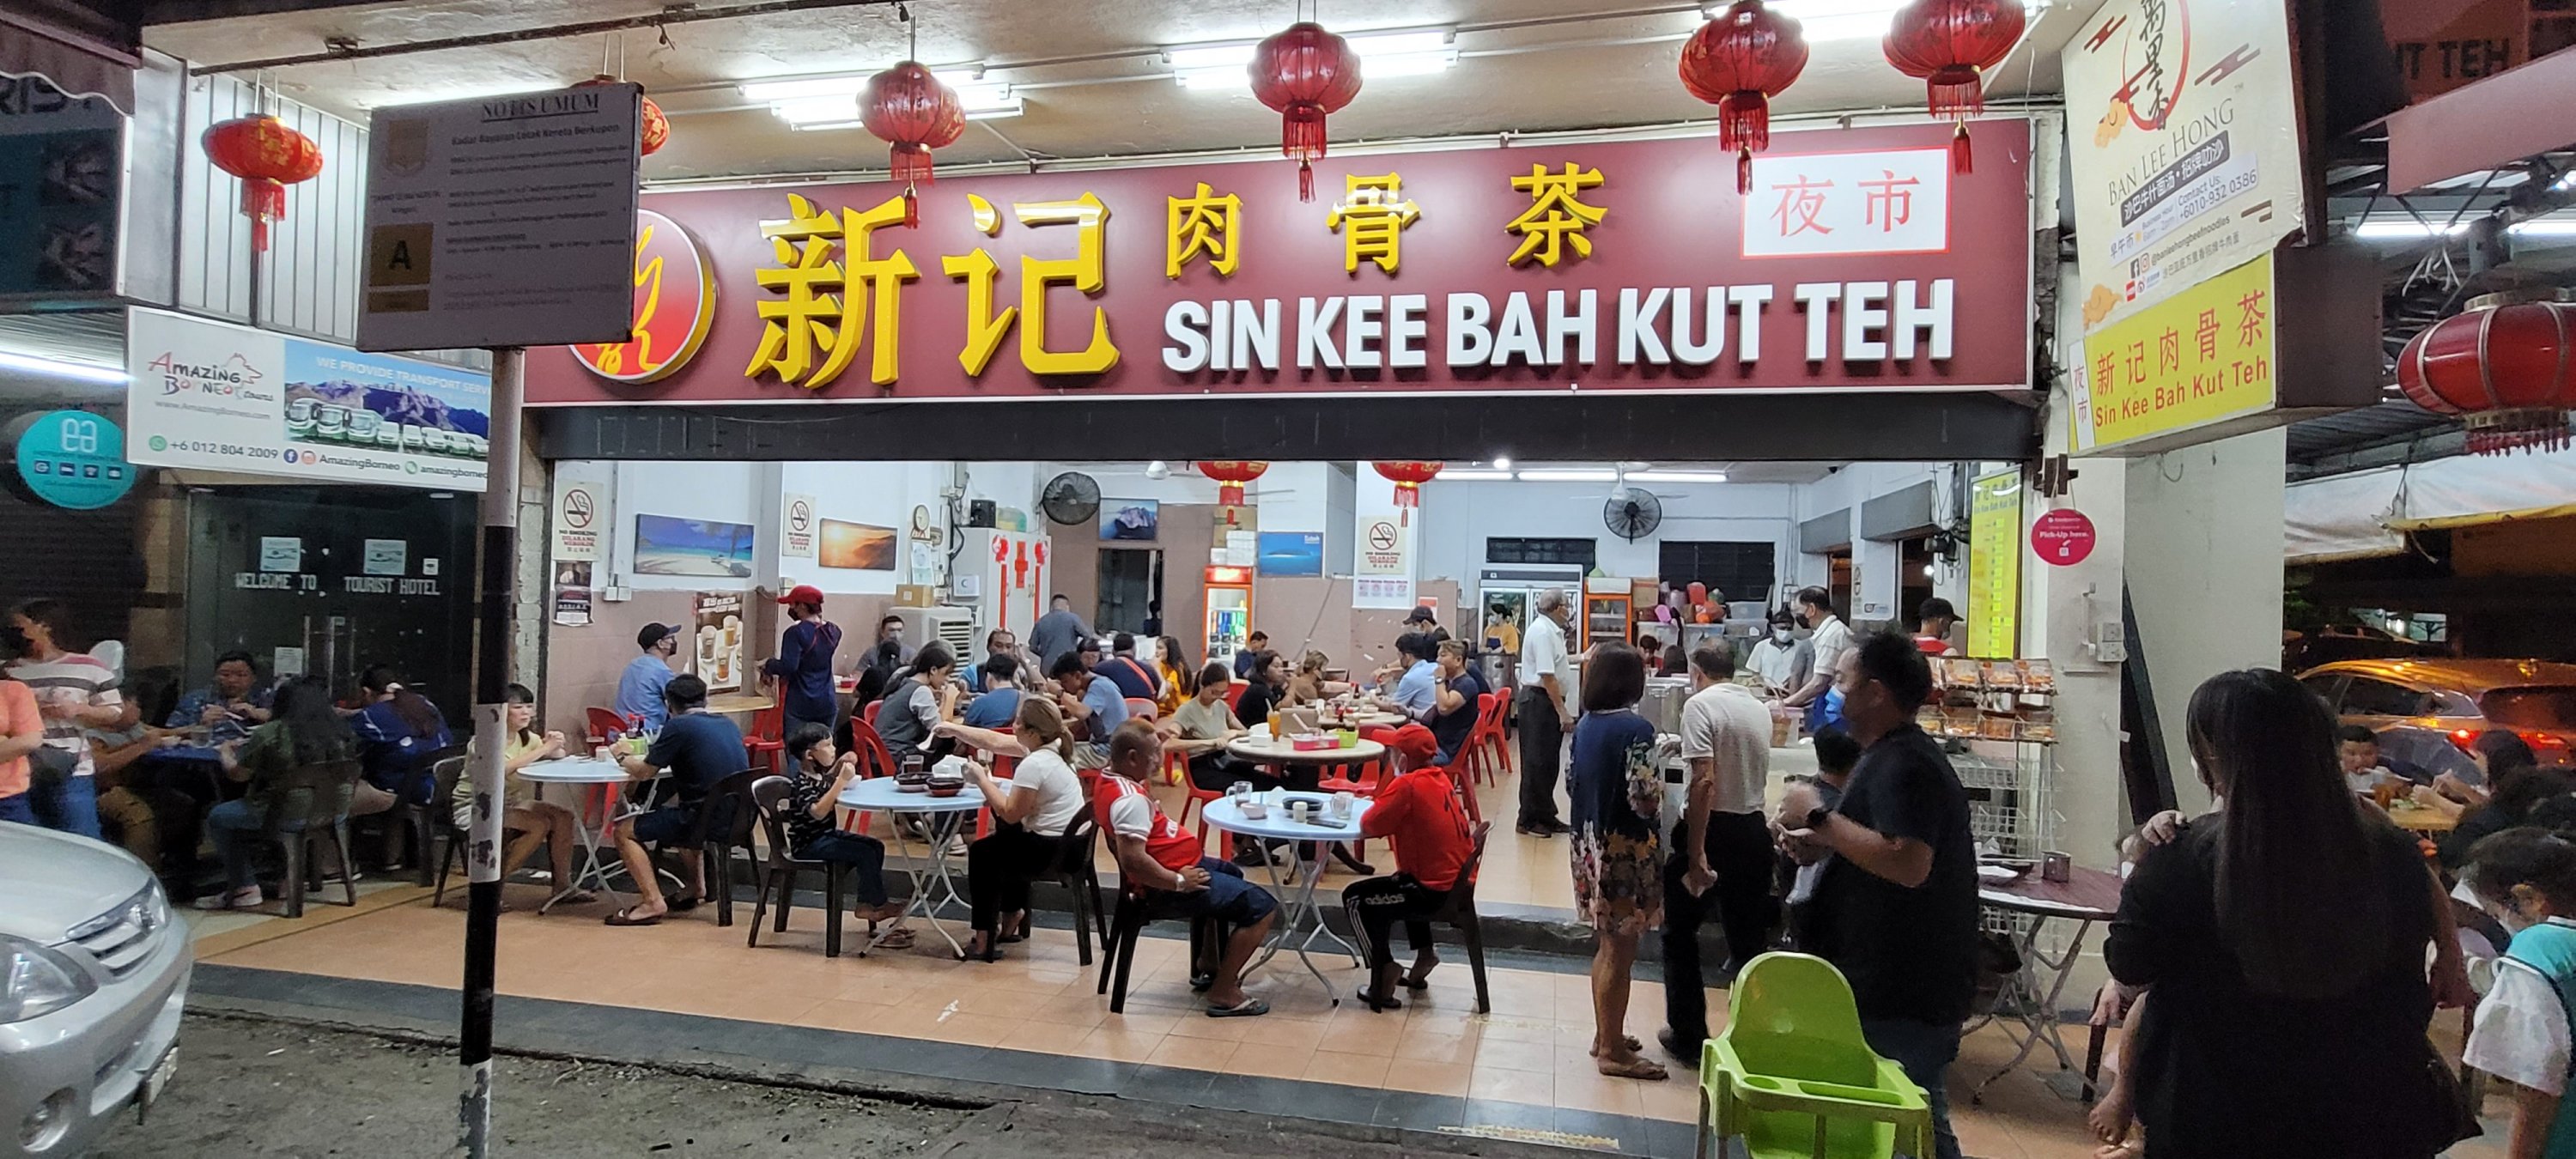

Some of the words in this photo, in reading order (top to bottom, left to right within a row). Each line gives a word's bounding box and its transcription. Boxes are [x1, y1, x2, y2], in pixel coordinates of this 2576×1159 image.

[2438, 38, 2511, 78] TEH
[541, 92, 599, 113] UMUM
[2108, 166, 2137, 207] BAN
[2141, 143, 2167, 179] LEE
[2172, 98, 2233, 158] HONG
[2178, 180, 2208, 207] Contact
[2229, 170, 2257, 194] 0386
[1164, 161, 1608, 280] 肉骨茶
[1769, 169, 1921, 238] 夜市
[388, 240, 412, 270] A
[743, 191, 1121, 391] 新记
[1162, 298, 1281, 373] SIN
[1297, 294, 1427, 371] KEE
[1447, 288, 1598, 367] BAH
[1617, 284, 1773, 366] KUT
[1795, 278, 1953, 361] TEH
[2096, 288, 2266, 397] 新记肉骨茶
[316, 355, 337, 370] WE
[340, 359, 394, 379] PROVIDE
[397, 369, 462, 390] TRANSPORT
[463, 381, 489, 396] SERV
[2073, 363, 2089, 424] 夜市
[2095, 404, 2116, 428] Sin
[2122, 396, 2148, 420] Kee
[2155, 380, 2185, 410] Bah
[2193, 368, 2224, 399] Kut
[2231, 355, 2267, 387] Teh
[170, 440, 189, 452] +6
[191, 441, 217, 454] 012
[220, 444, 244, 456] 804
[247, 446, 279, 459] 2009
[319, 453, 401, 471] AmazingBorneo
[235, 572, 292, 590] WELCOME
[301, 573, 318, 590] TO
[344, 576, 394, 593] TOURIST
[399, 578, 441, 596] HOTEL
[1365, 893, 1406, 906] adidas
